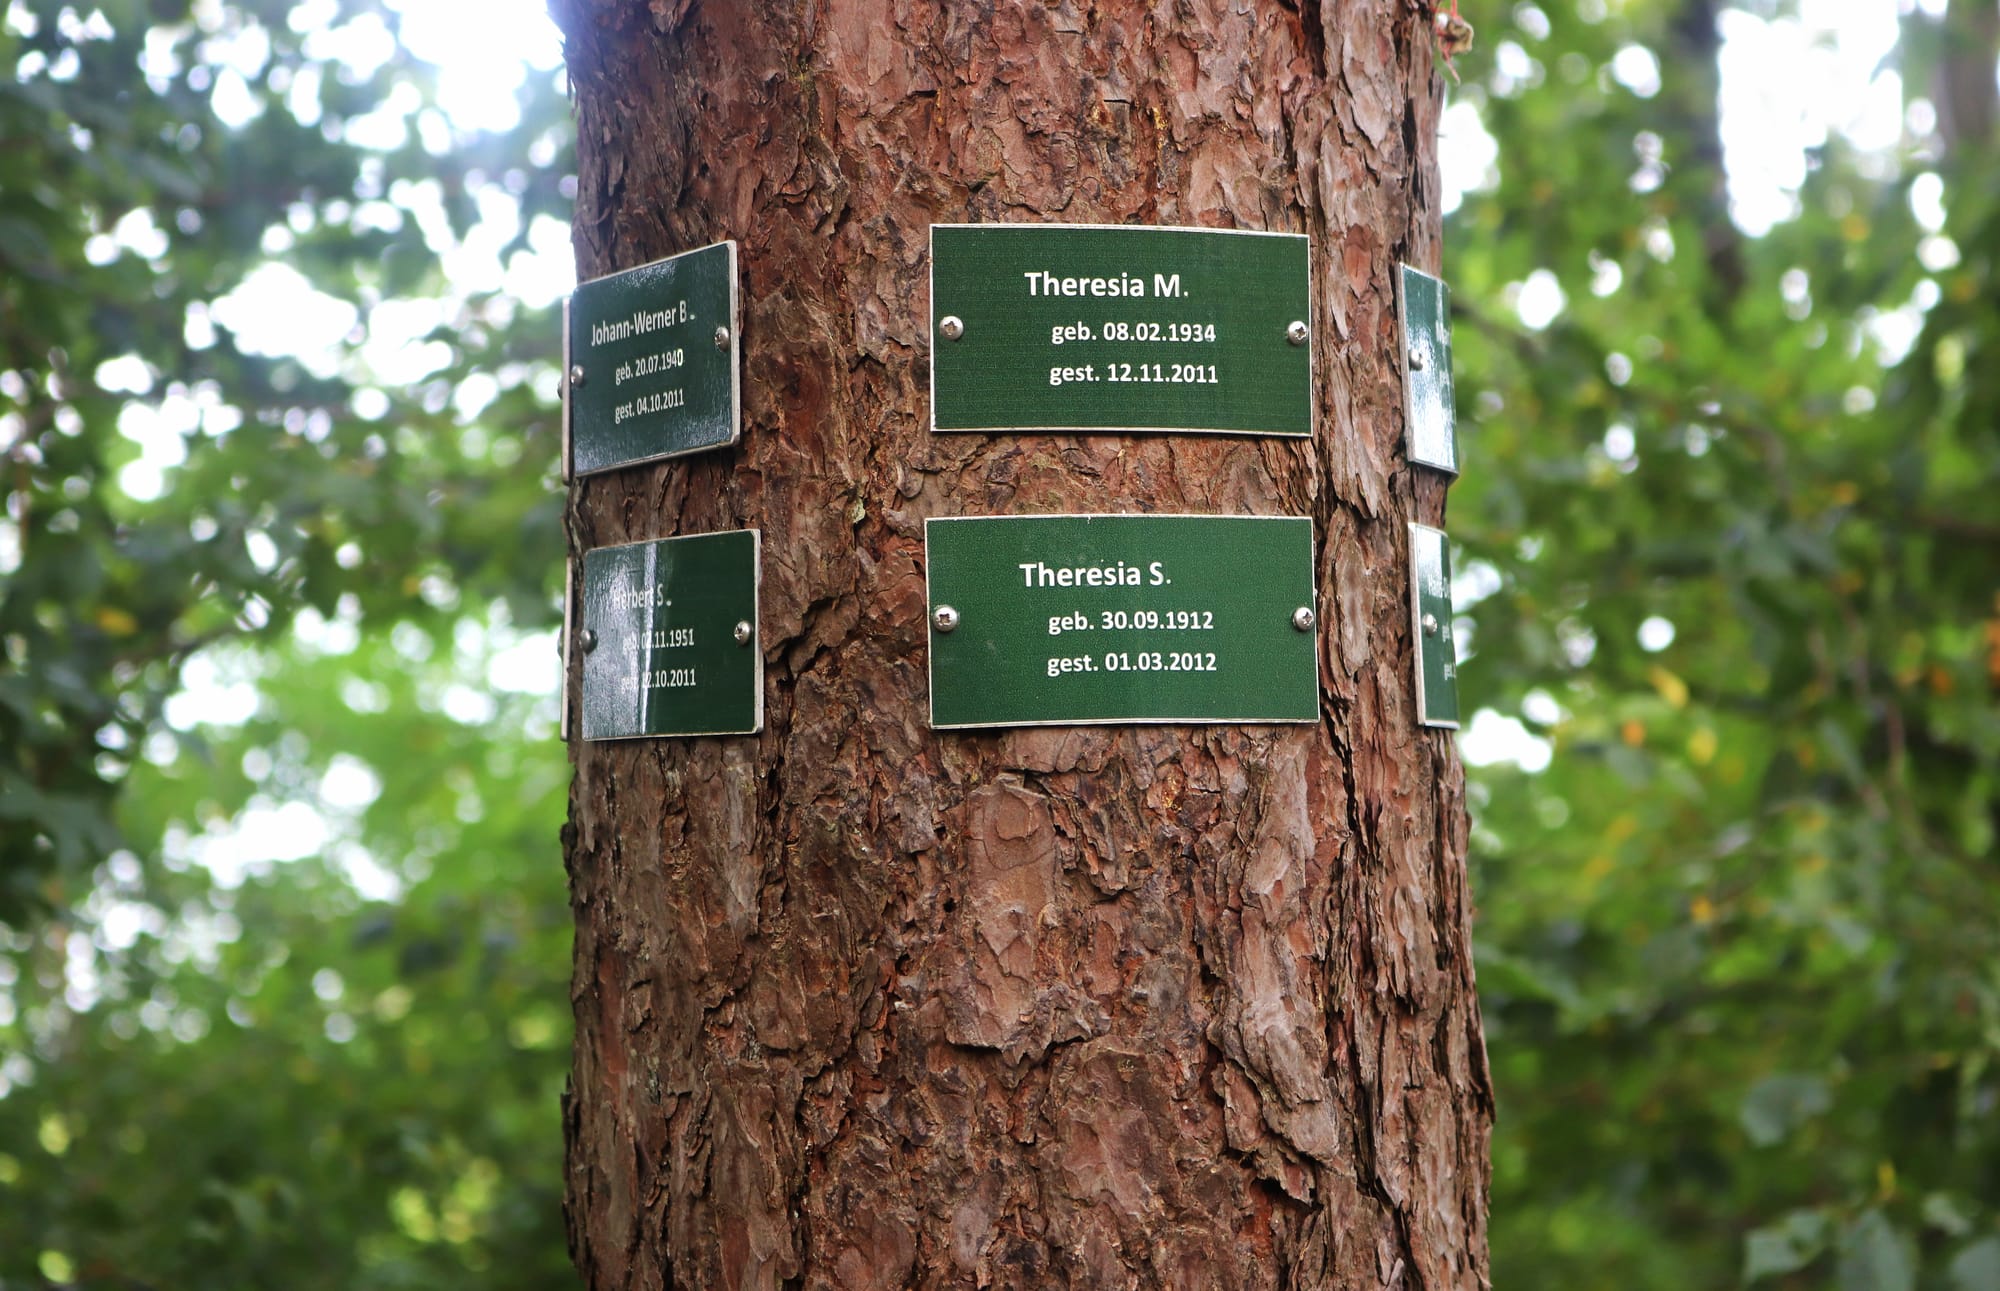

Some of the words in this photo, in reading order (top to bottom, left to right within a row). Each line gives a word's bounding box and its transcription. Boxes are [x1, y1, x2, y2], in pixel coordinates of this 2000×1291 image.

[1024, 271, 1145, 298] Theresia
[1154, 273, 1189, 298] M.
[591, 306, 677, 347] Johann-Werner
[1051, 321, 1097, 345] geb.
[1103, 323, 1217, 343] 08.02.1934
[615, 362, 634, 386] geb.
[635, 348, 684, 377] 20.07.1940
[1049, 364, 1100, 385] gest.
[1107, 363, 1219, 384] 12.11.2011
[615, 400, 635, 425] gest.
[636, 388, 685, 415] 04.10.2011
[1019, 561, 1142, 587] Theresia
[1149, 562, 1172, 586] S.
[657, 583, 672, 607] S.
[1048, 610, 1094, 635] geb.
[1101, 611, 1214, 631] 30.09.1912
[1047, 653, 1098, 677] gest.
[1105, 652, 1217, 672] 01.03.2012
